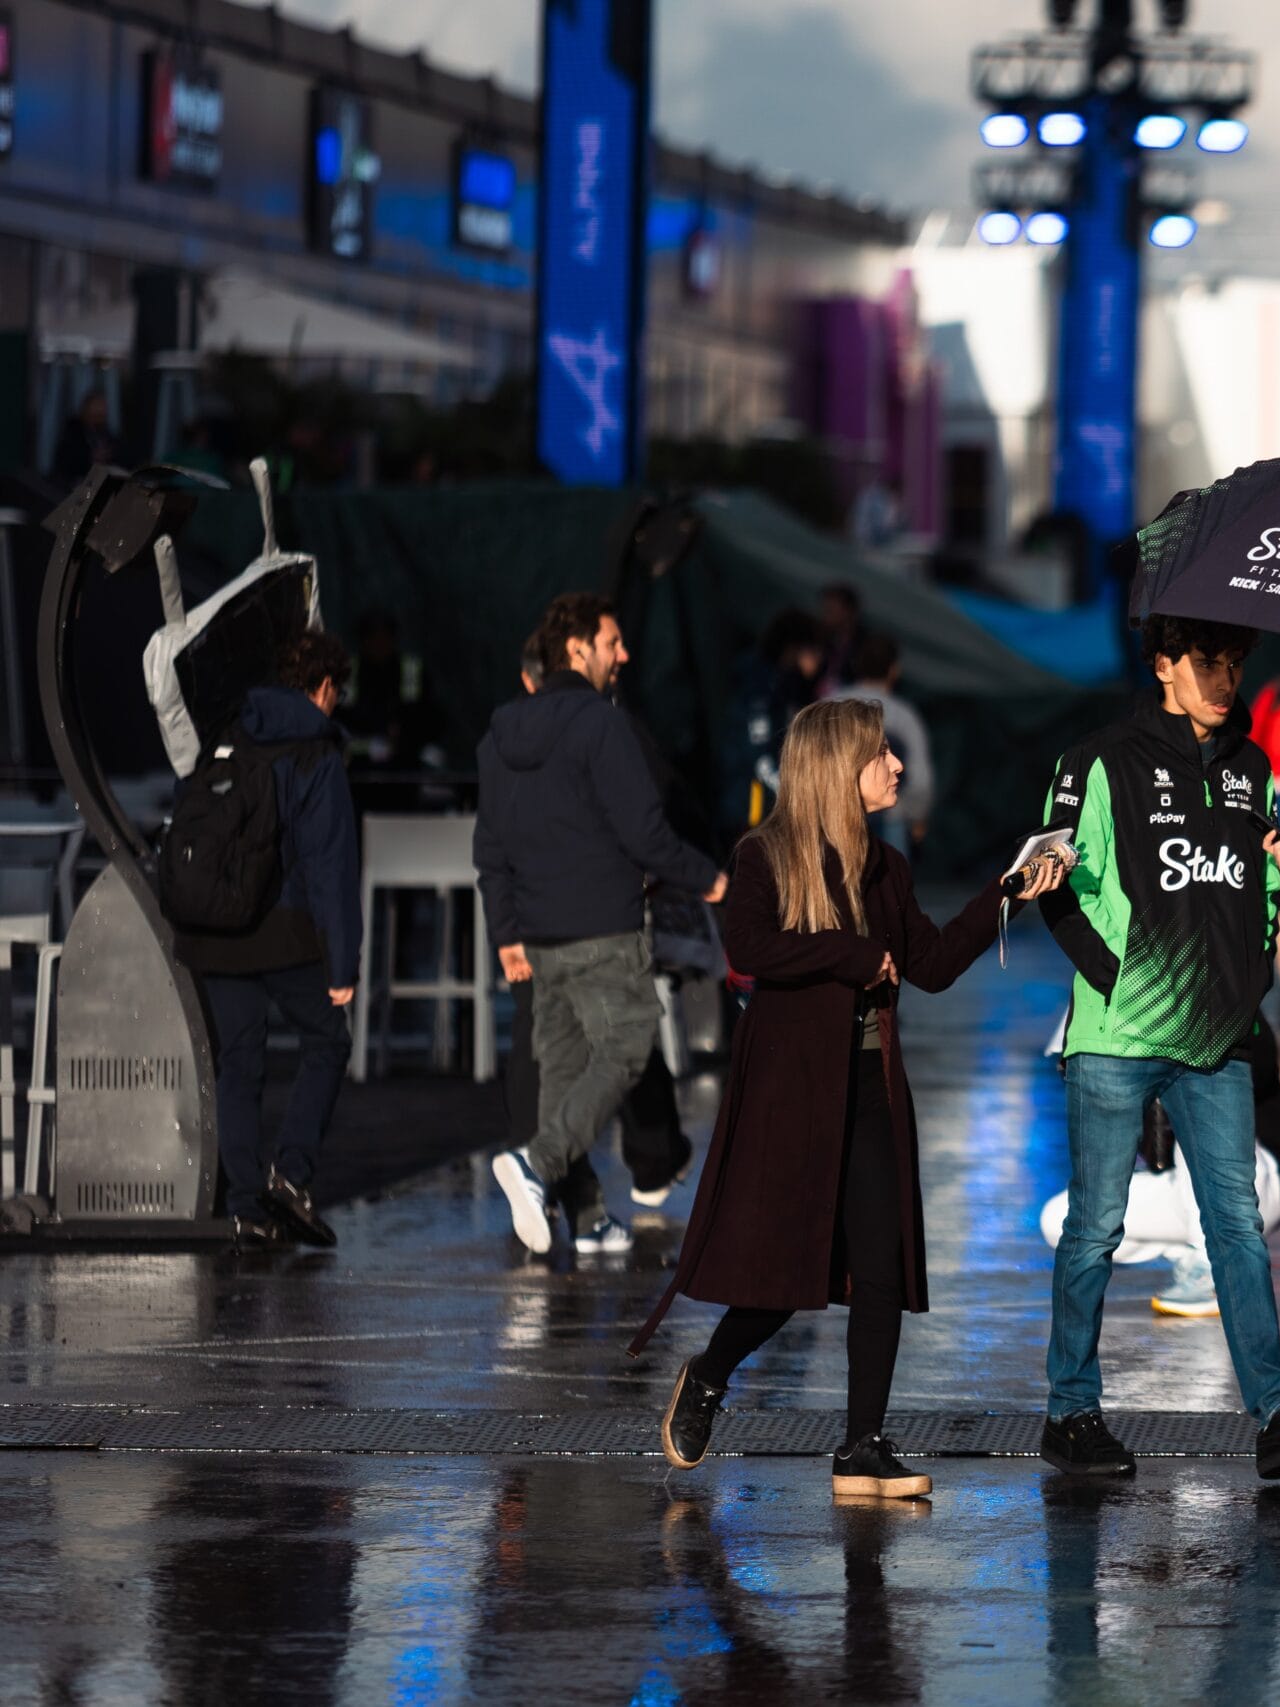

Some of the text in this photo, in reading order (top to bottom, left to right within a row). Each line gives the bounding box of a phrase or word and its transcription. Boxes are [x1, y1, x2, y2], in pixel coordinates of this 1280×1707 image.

[1249, 565, 1264, 575] F1
[1229, 576, 1260, 591] KICK
[1222, 769, 1252, 795] Stake
[1159, 838, 1245, 892] Stake
